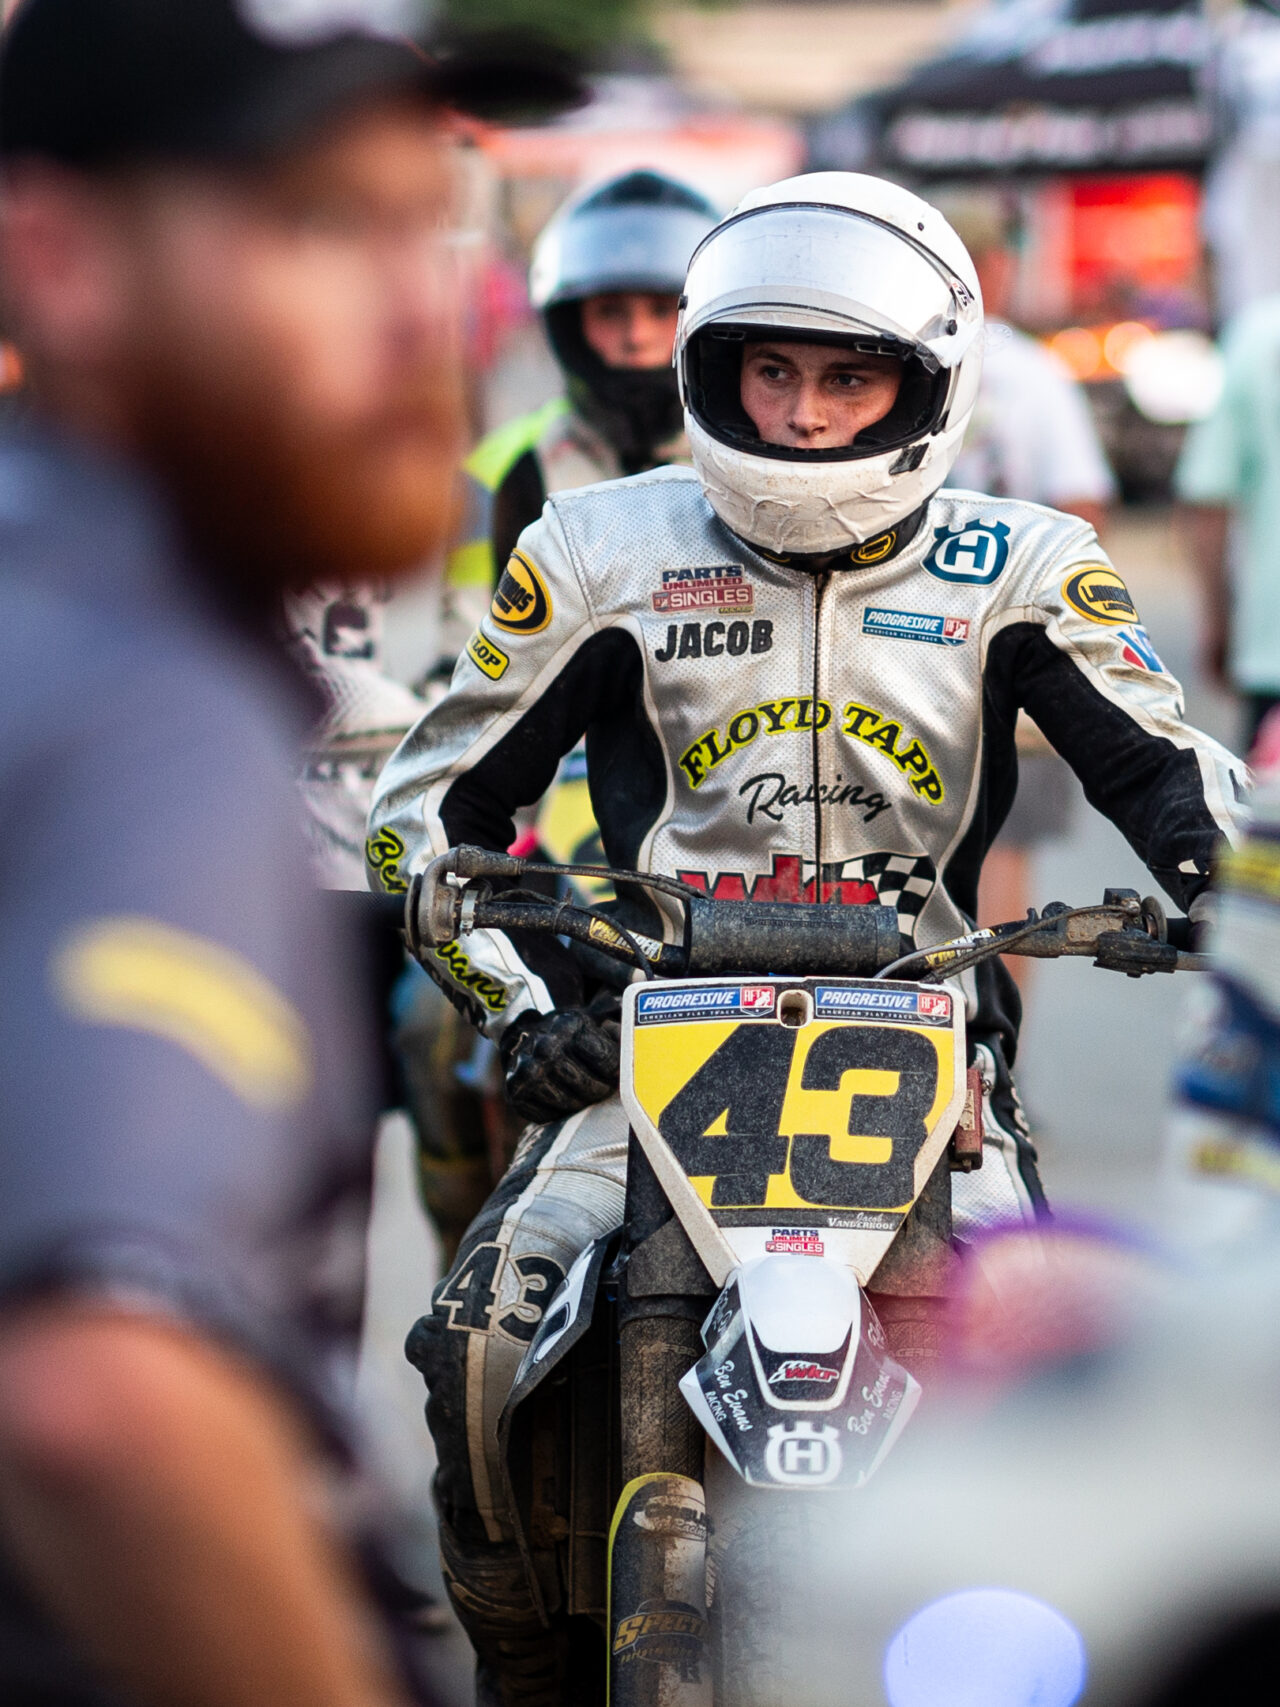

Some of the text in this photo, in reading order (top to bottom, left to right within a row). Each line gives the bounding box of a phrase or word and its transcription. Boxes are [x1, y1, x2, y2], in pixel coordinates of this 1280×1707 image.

[662, 565, 743, 582] PARTS
[662, 577, 743, 590] UNLIMITED
[670, 588, 749, 608] SINGLES
[866, 611, 941, 632] PROGRESSIVE
[466, 638, 502, 667] LOP
[655, 619, 774, 662] JACOB
[679, 696, 945, 805] FLOYD TAPP
[738, 773, 892, 825] Racing
[436, 939, 507, 1011] vans
[642, 990, 736, 1011] PROGRESSIVE
[820, 990, 914, 1009] PROGRESSIVE
[658, 1022, 940, 1209] 43
[771, 1228, 819, 1237] PARTS
[775, 1241, 823, 1253] SINGLES
[436, 1241, 568, 1347] 43
[714, 1359, 735, 1389] Ben
[705, 1390, 727, 1423] RACING
[722, 1388, 753, 1432] Evans
[846, 1408, 876, 1436] Ben
